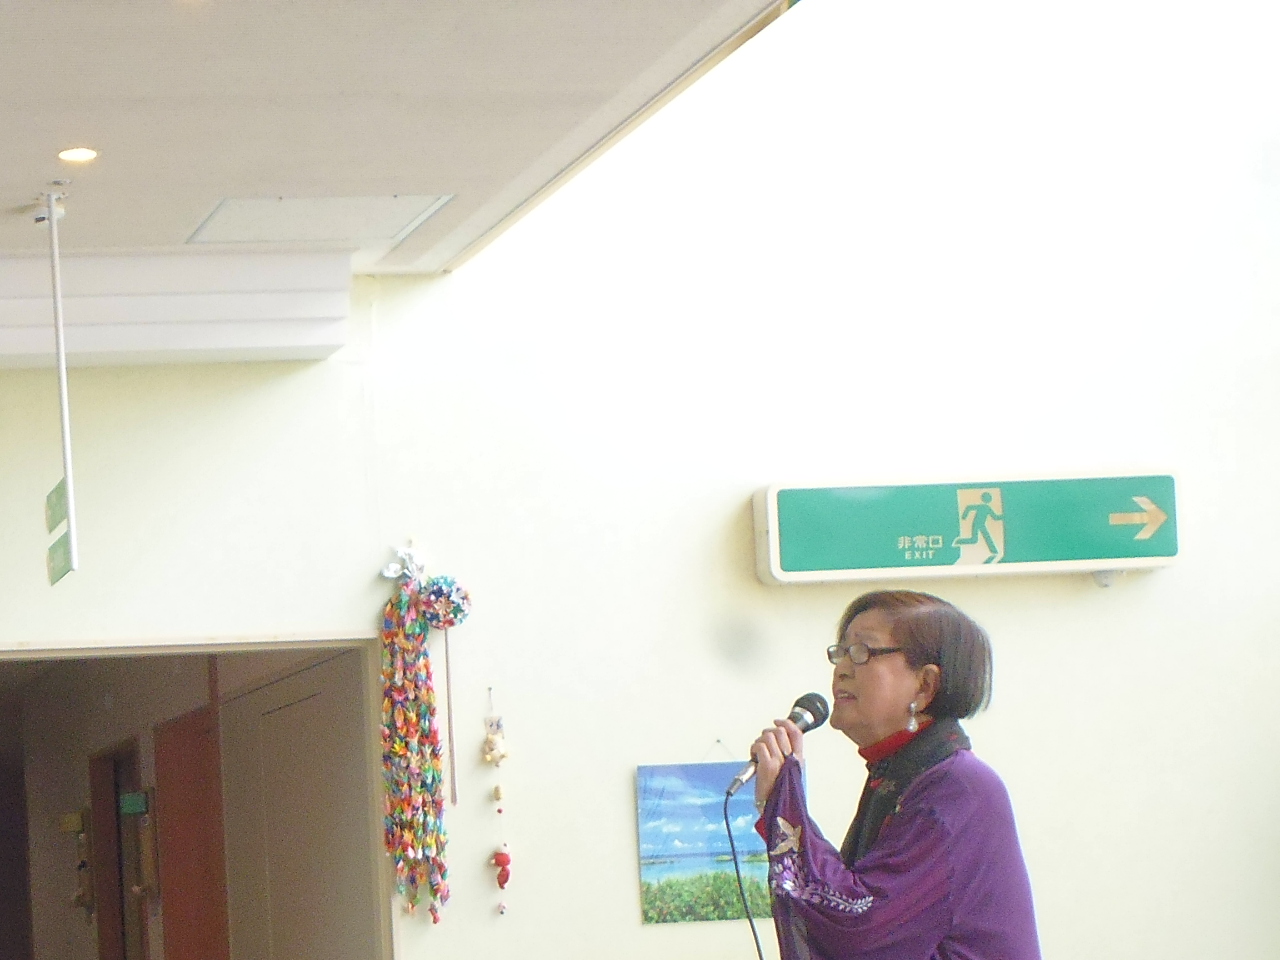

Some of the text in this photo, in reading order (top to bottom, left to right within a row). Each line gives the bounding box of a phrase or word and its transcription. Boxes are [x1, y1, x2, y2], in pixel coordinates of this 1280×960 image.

[897, 534, 943, 549] 非常口
[905, 550, 935, 560] EXIT
